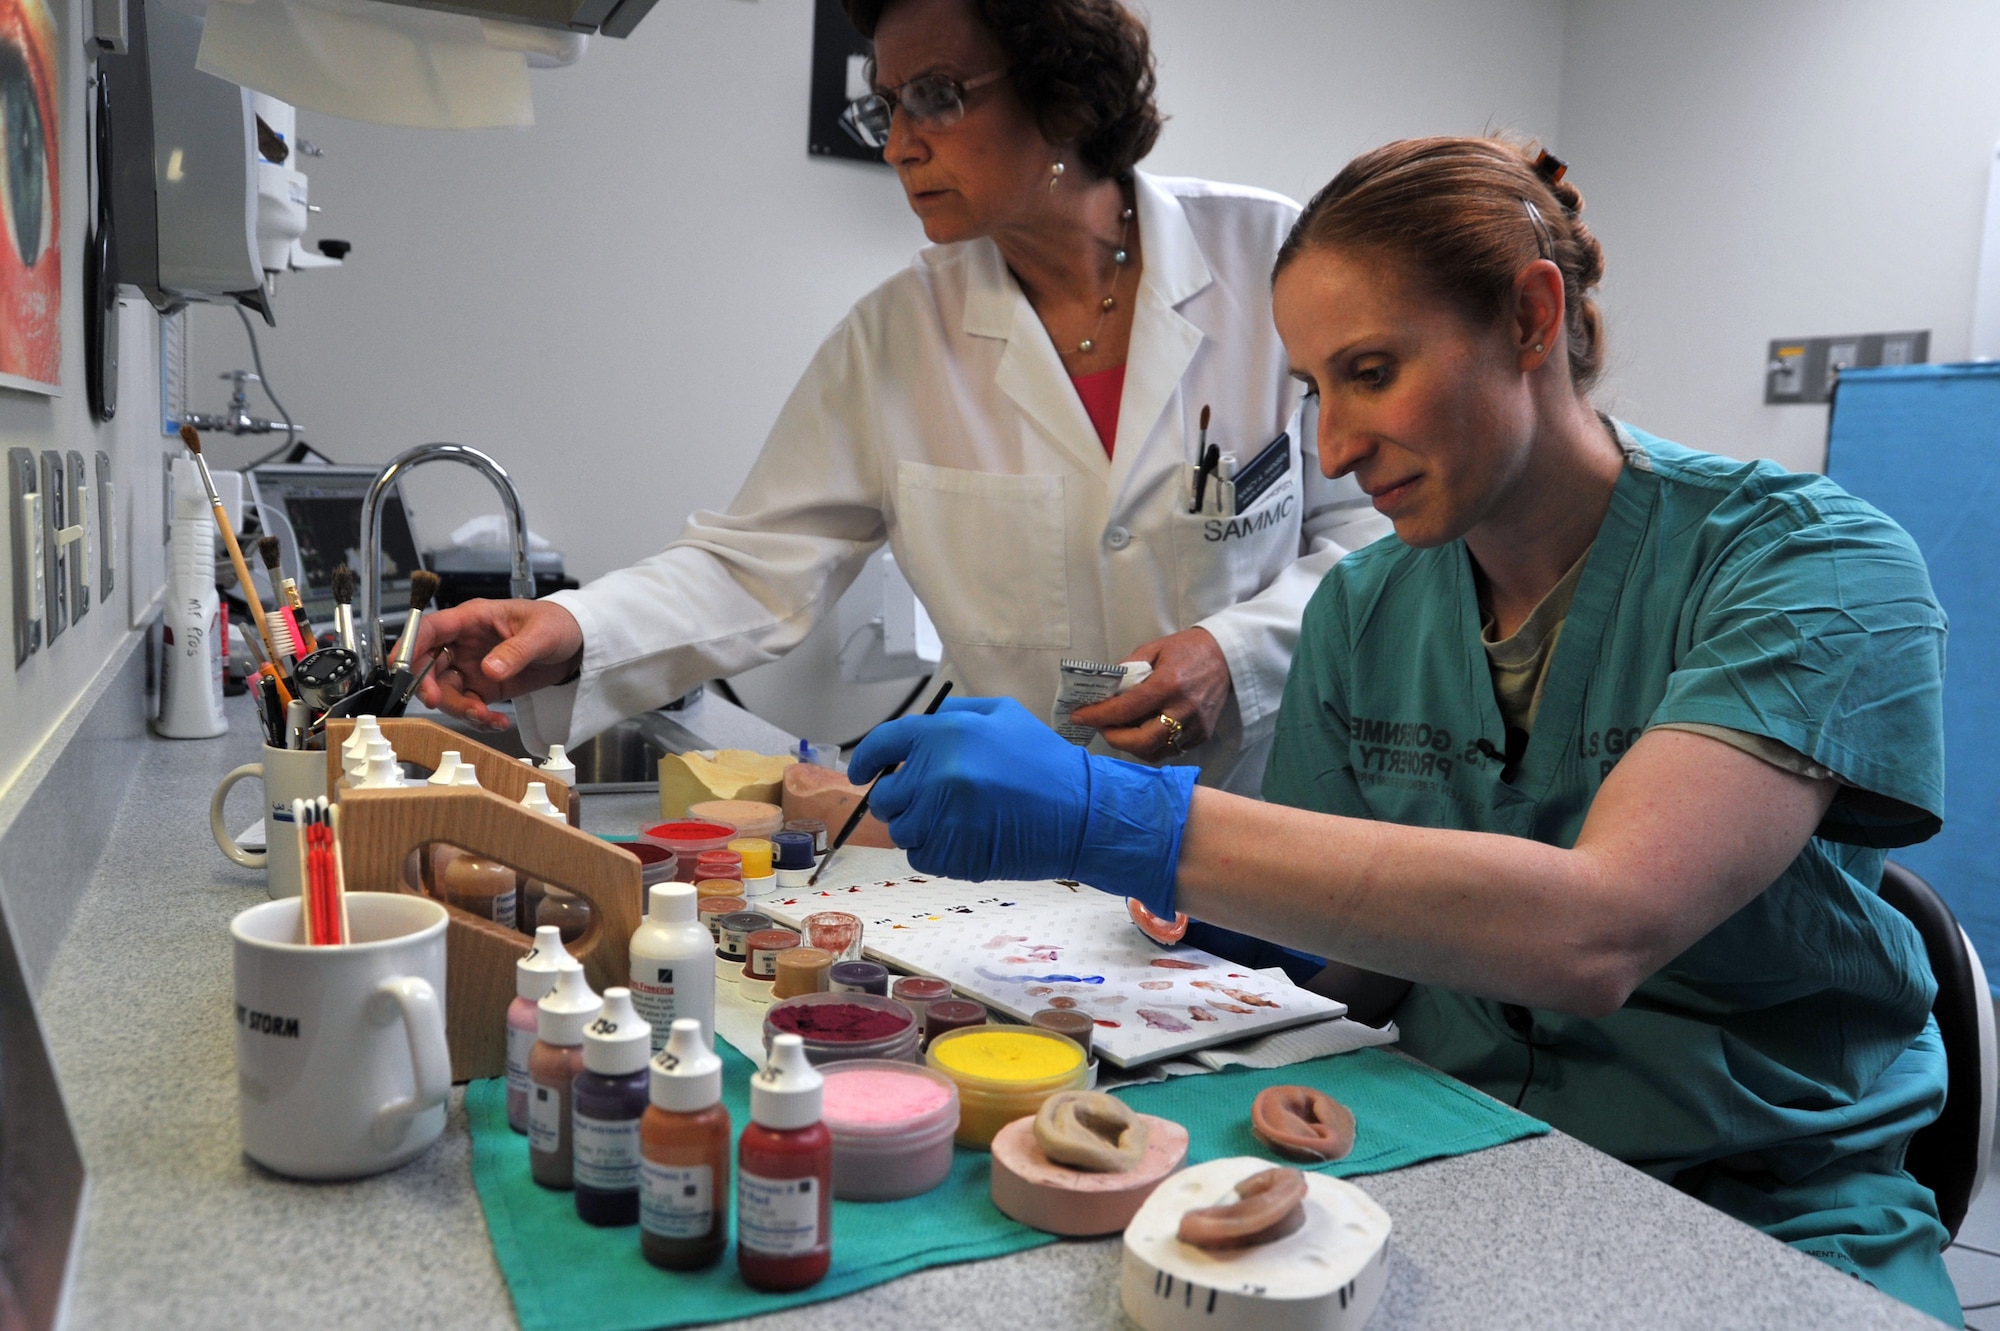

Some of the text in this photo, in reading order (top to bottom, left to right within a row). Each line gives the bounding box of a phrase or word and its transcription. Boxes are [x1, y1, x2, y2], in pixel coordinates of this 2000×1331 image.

[1204, 495, 1294, 542] SAMMC
[187, 626, 204, 657] Pros
[640, 982, 674, 995] Freezing
[248, 1010, 300, 1040] STORM
